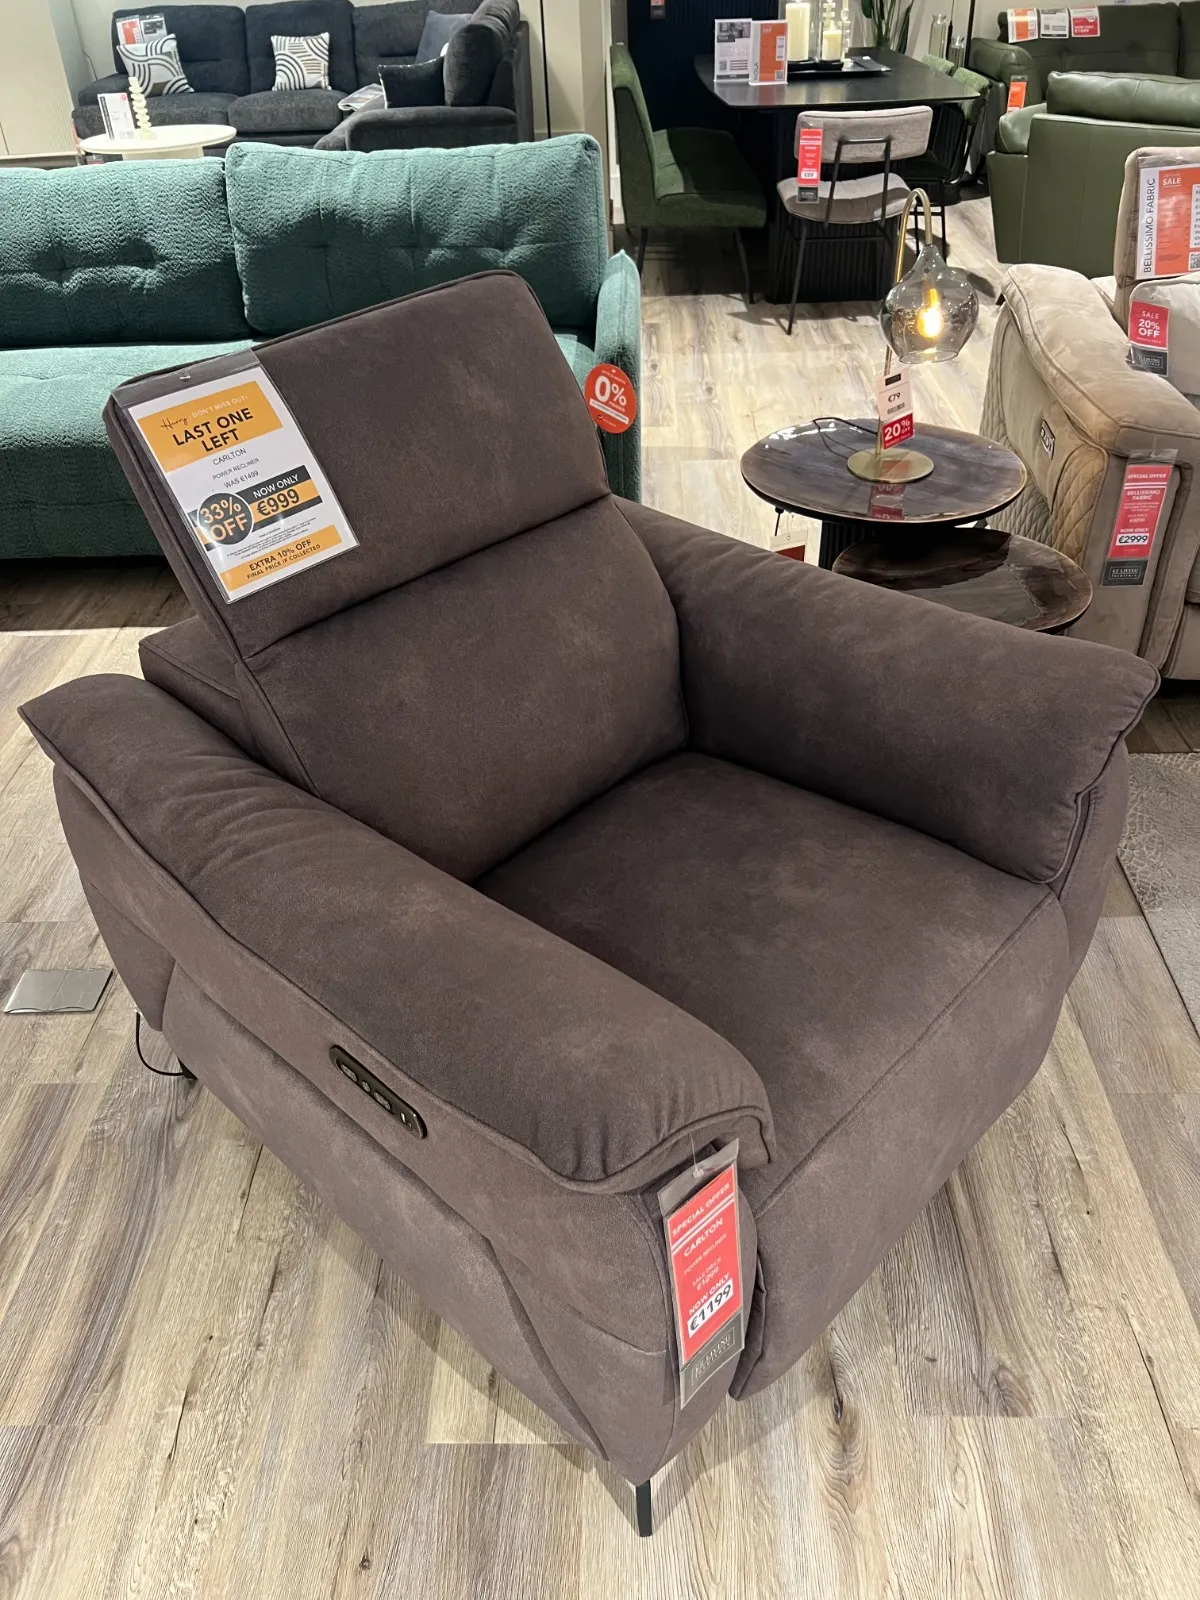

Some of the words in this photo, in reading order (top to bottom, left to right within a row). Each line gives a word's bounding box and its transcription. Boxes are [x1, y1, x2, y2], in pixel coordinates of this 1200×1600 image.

[1146, 178, 1155, 213] FABRIC
[1162, 178, 1181, 186] SALE
[1144, 216, 1154, 273] BELLISSIMO
[1138, 319, 1160, 331] 20%
[1141, 311, 1160, 319] SALE
[1138, 328, 1160, 338] OFF
[595, 375, 627, 406] 0%
[888, 392, 901, 403] €79
[160, 417, 188, 430] Hurry
[191, 408, 214, 419] DON'T
[214, 401, 231, 411] MISS
[172, 421, 213, 446] LAST
[216, 407, 254, 429] ONE
[201, 428, 239, 453] LEFT
[212, 447, 247, 466] CARLTON
[212, 468, 233, 481] POWER
[233, 458, 260, 473] RECLINER
[224, 478, 240, 489] WAS
[240, 470, 259, 483] €1499
[253, 483, 276, 499] NOW
[276, 474, 300, 489] ONLY
[200, 497, 242, 525] 33%
[257, 488, 300, 517] €999
[209, 513, 248, 542] OFF
[1118, 535, 1148, 544] €2999
[246, 569, 265, 580] FINAL
[265, 562, 283, 573] PRICE
[289, 544, 321, 561] COLLECTED
[249, 555, 277, 572] EXTRA
[277, 547, 295, 560] 10%
[295, 539, 313, 552] OFF
[672, 1207, 704, 1237] SPECIAL
[705, 1182, 730, 1208] OFFER
[683, 1217, 723, 1257] CARLTON
[684, 1256, 703, 1276] POWER
[702, 1233, 727, 1257] RECLINER
[692, 1270, 705, 1286] SALE
[706, 1257, 722, 1273] PRICE
[688, 1292, 709, 1316] NOW
[709, 1272, 731, 1295] ONLY
[690, 1284, 732, 1331] €1199
[705, 1333, 731, 1361] LIVING
